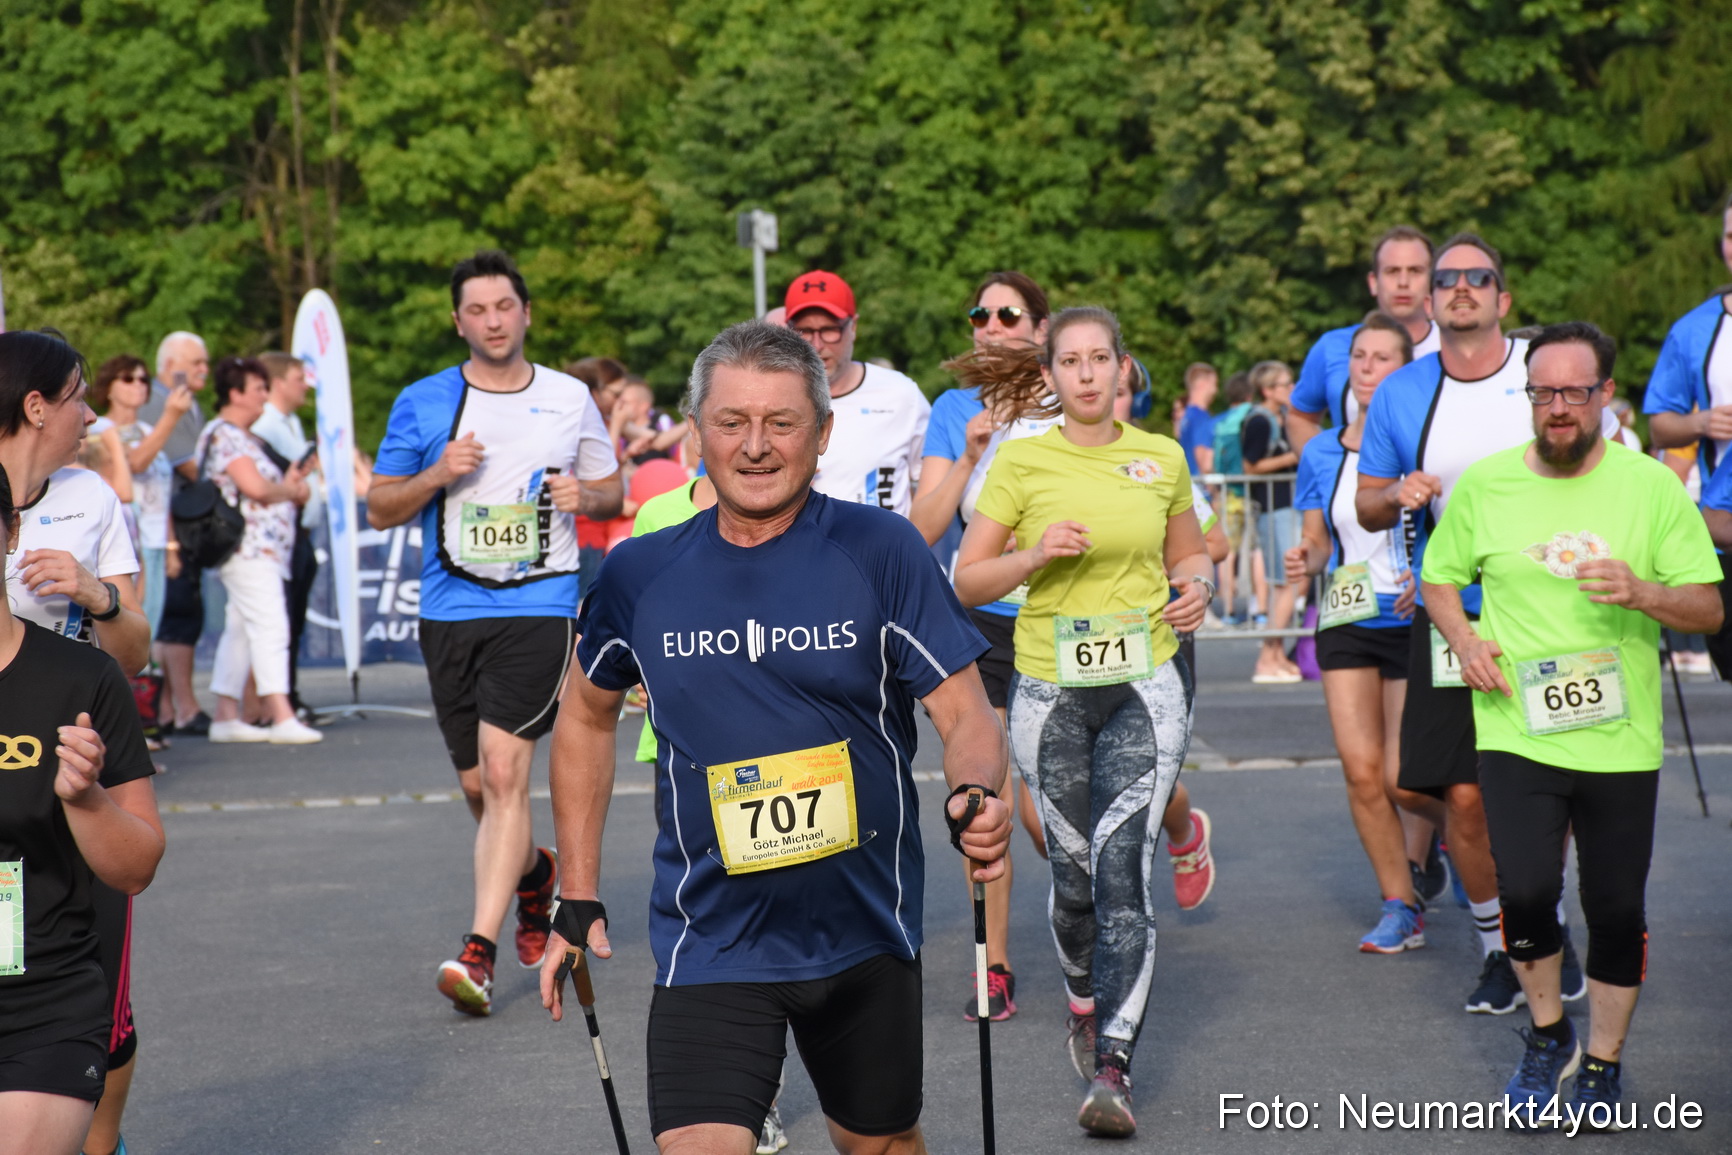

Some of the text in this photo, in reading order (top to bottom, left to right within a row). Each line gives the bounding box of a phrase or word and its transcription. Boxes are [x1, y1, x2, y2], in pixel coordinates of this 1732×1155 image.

[469, 524, 528, 547] 1048
[663, 620, 858, 657] EURO POLES
[1075, 637, 1127, 667] 671
[1077, 663, 1132, 675] Weikert Nadine
[1544, 678, 1603, 711] 663
[1548, 705, 1606, 720] Bebic Miroslav
[728, 775, 783, 796] firmenlauf
[791, 775, 817, 791] walk
[819, 772, 843, 787] 2019
[740, 788, 822, 840] 707
[742, 836, 837, 862] Europoles GmbH & Co. KG
[753, 829, 824, 851] Götz Michael
